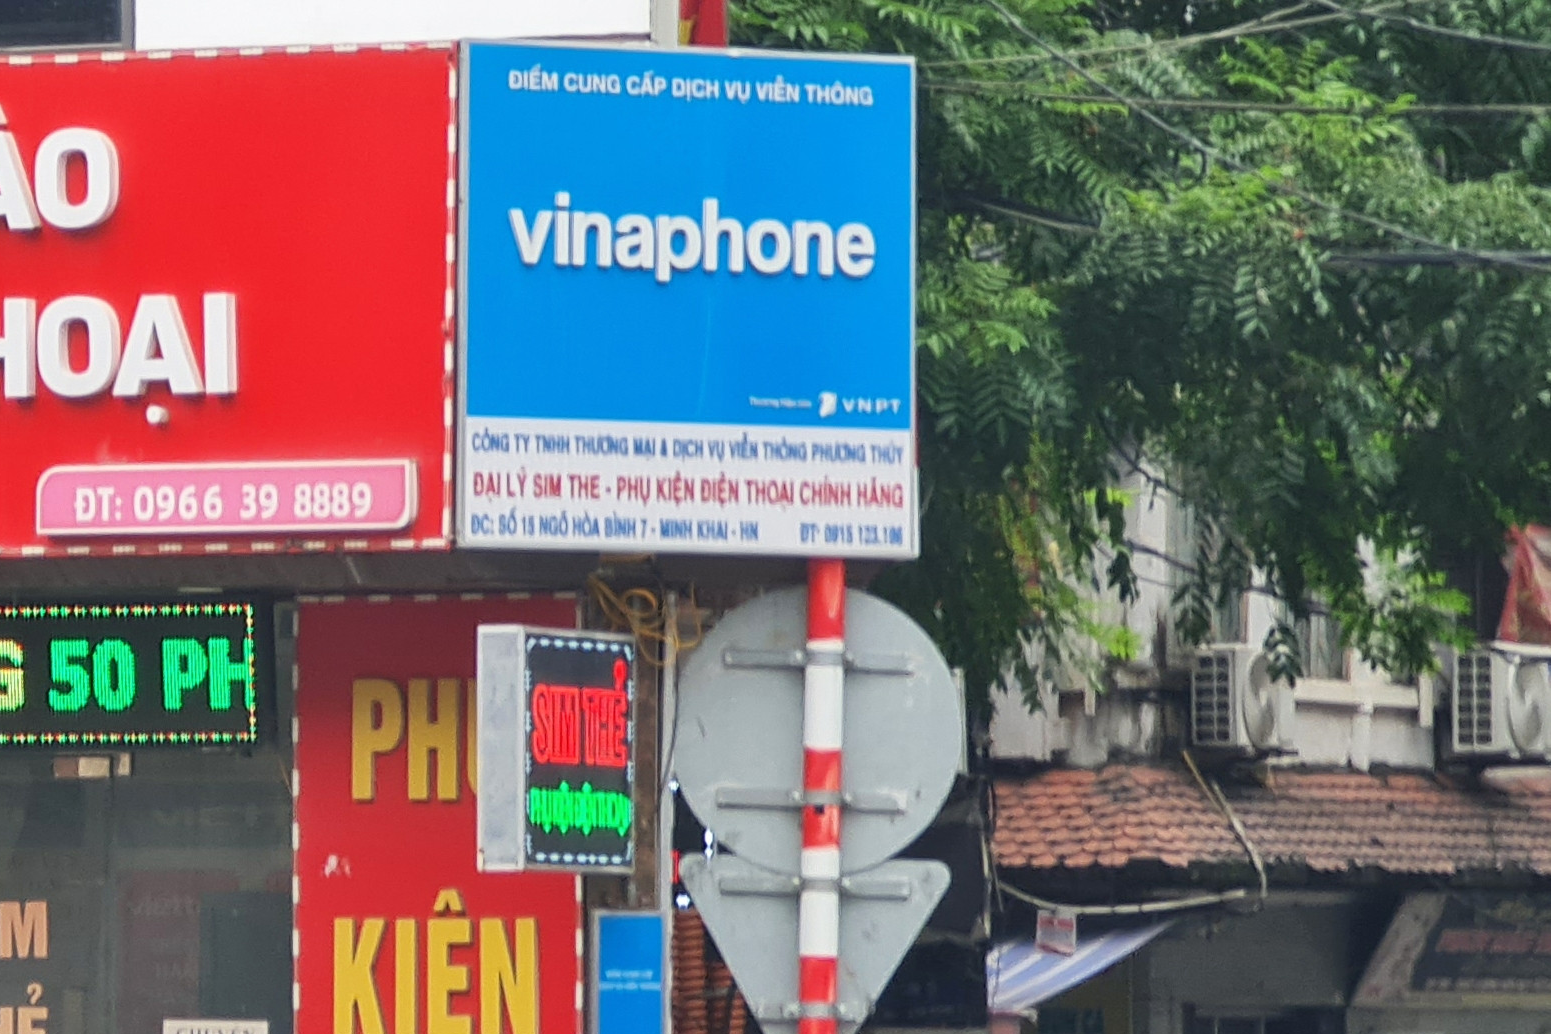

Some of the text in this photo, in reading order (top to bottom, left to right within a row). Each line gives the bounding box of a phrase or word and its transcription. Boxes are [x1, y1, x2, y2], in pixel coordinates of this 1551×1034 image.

[564, 73, 620, 93] CUNG
[671, 78, 720, 102] DỊCH
[805, 81, 873, 106] THÔNG
[509, 190, 877, 283] vinaphone
[842, 397, 901, 414] VNPT
[513, 433, 530, 454] TY
[74, 482, 372, 522] ĐT: 0966 39 8889
[533, 472, 562, 499] SIM
[616, 475, 651, 507] PHỤ
[656, 470, 695, 506] KIỆN
[49, 638, 136, 713] 50
[350, 677, 478, 803] PH
